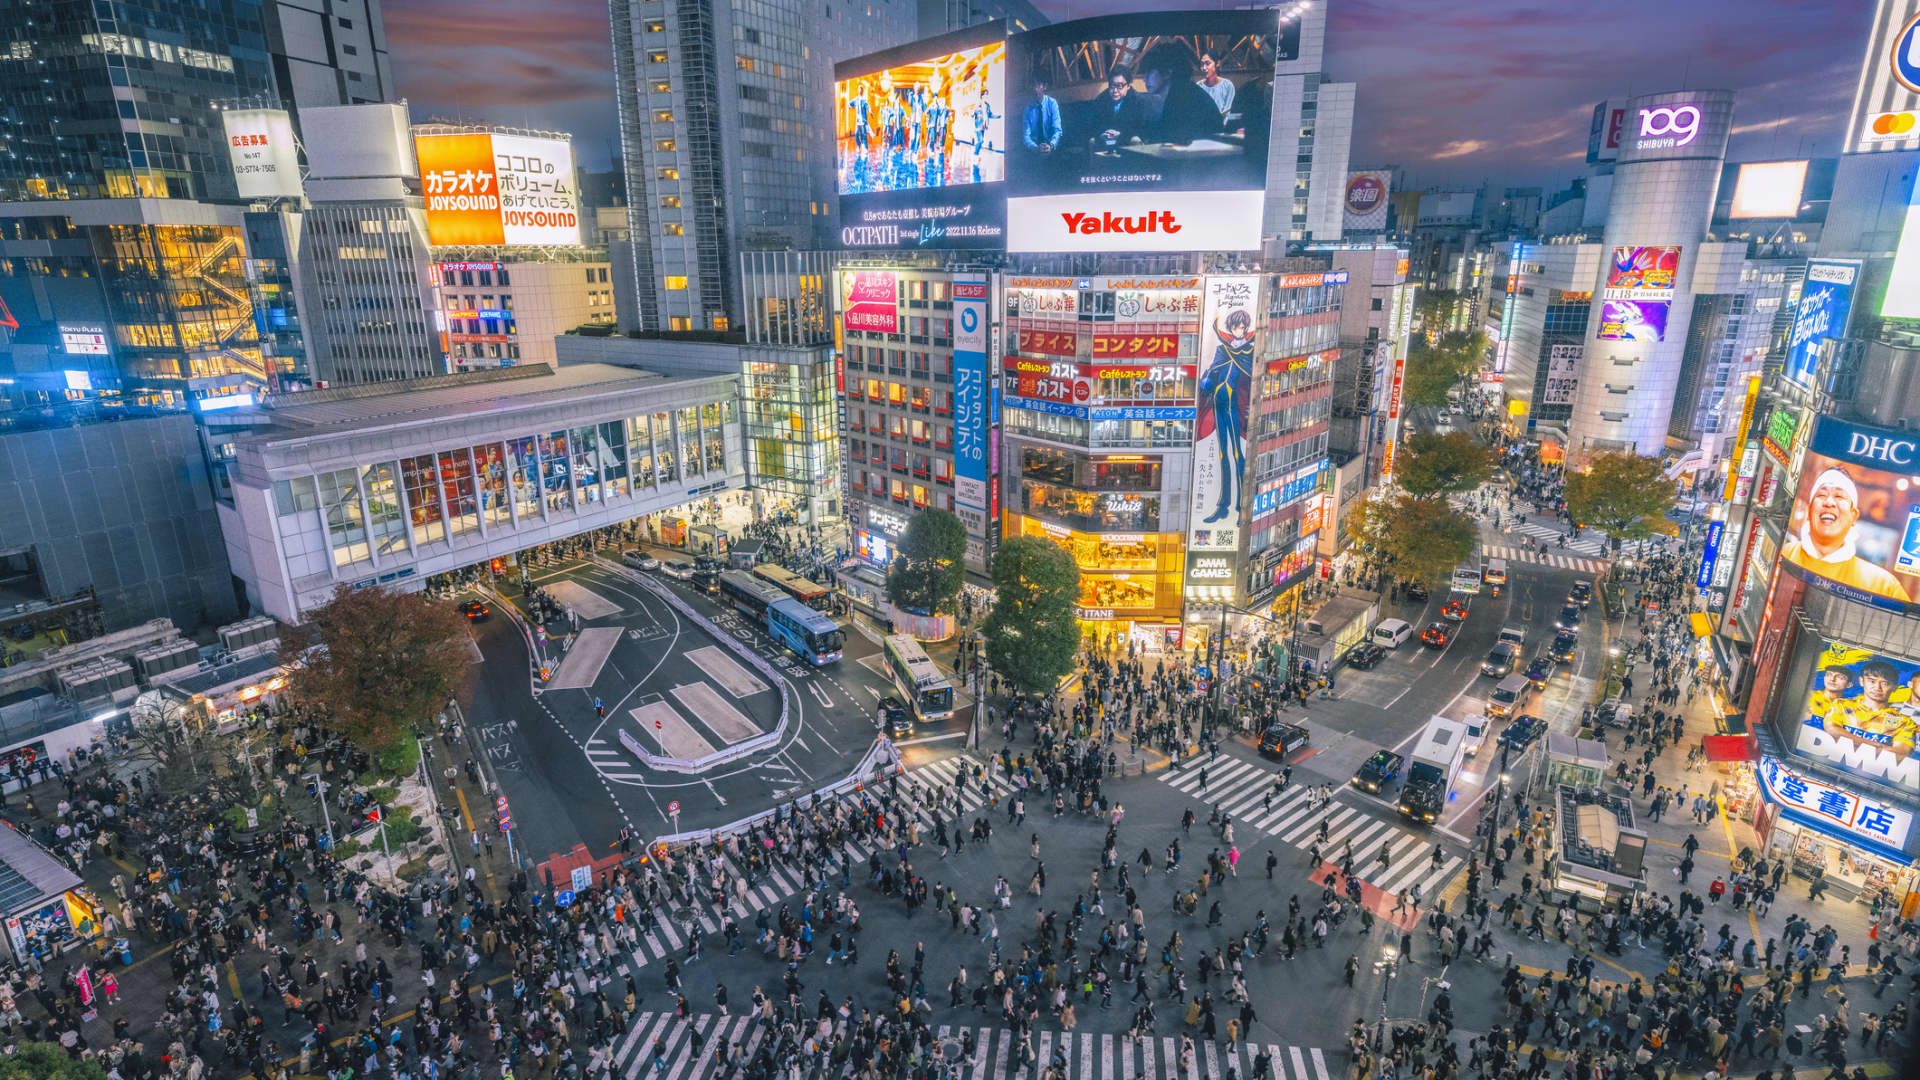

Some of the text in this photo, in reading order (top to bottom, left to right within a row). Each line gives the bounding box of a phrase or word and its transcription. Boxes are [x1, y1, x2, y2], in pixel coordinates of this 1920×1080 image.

[1639, 105, 1701, 146] 109
[232, 134, 268, 147] 広告募集
[1637, 138, 1674, 150] SHIBUYA
[497, 154, 555, 174] ココロの
[425, 169, 492, 194] カラオケ
[501, 174, 573, 195] ボリューム、
[429, 195, 498, 211] JOYSOUND
[502, 193, 575, 210] あげていこう。
[504, 210, 577, 228] JOYSOUND
[1061, 211, 1182, 235] Yakult
[842, 225, 899, 246] OCTPATH
[920, 219, 944, 245] Like
[946, 226, 976, 236] 2022.11.16
[977, 225, 1001, 235] Release
[865, 274, 894, 287] 品川スキン
[1107, 278, 1199, 289] しゃぶしゃぶバイキング
[1007, 297, 1019, 308] 9F
[1039, 295, 1076, 313] しゃぶ葉
[1145, 294, 1199, 313] しゃぶ葉
[851, 313, 894, 327] 品川美容外科
[1094, 337, 1176, 352] コンタクト
[1050, 362, 1080, 379] ガスト
[1099, 367, 1188, 381] Caféレストラン ガスト
[1006, 377, 1019, 389] 7F
[1036, 379, 1070, 399] ガスト
[957, 368, 971, 458] アイシティ
[972, 369, 982, 460] コンタクトの
[1124, 409, 1195, 418] 英会話イーオン
[1848, 432, 1916, 464] DHC
[1296, 534, 1315, 554] LUSH
[1197, 558, 1227, 568] DMM
[1191, 568, 1232, 579] GAMES
[1836, 585, 1873, 603] Channel
[1761, 755, 1896, 836] 大盛堂書店
